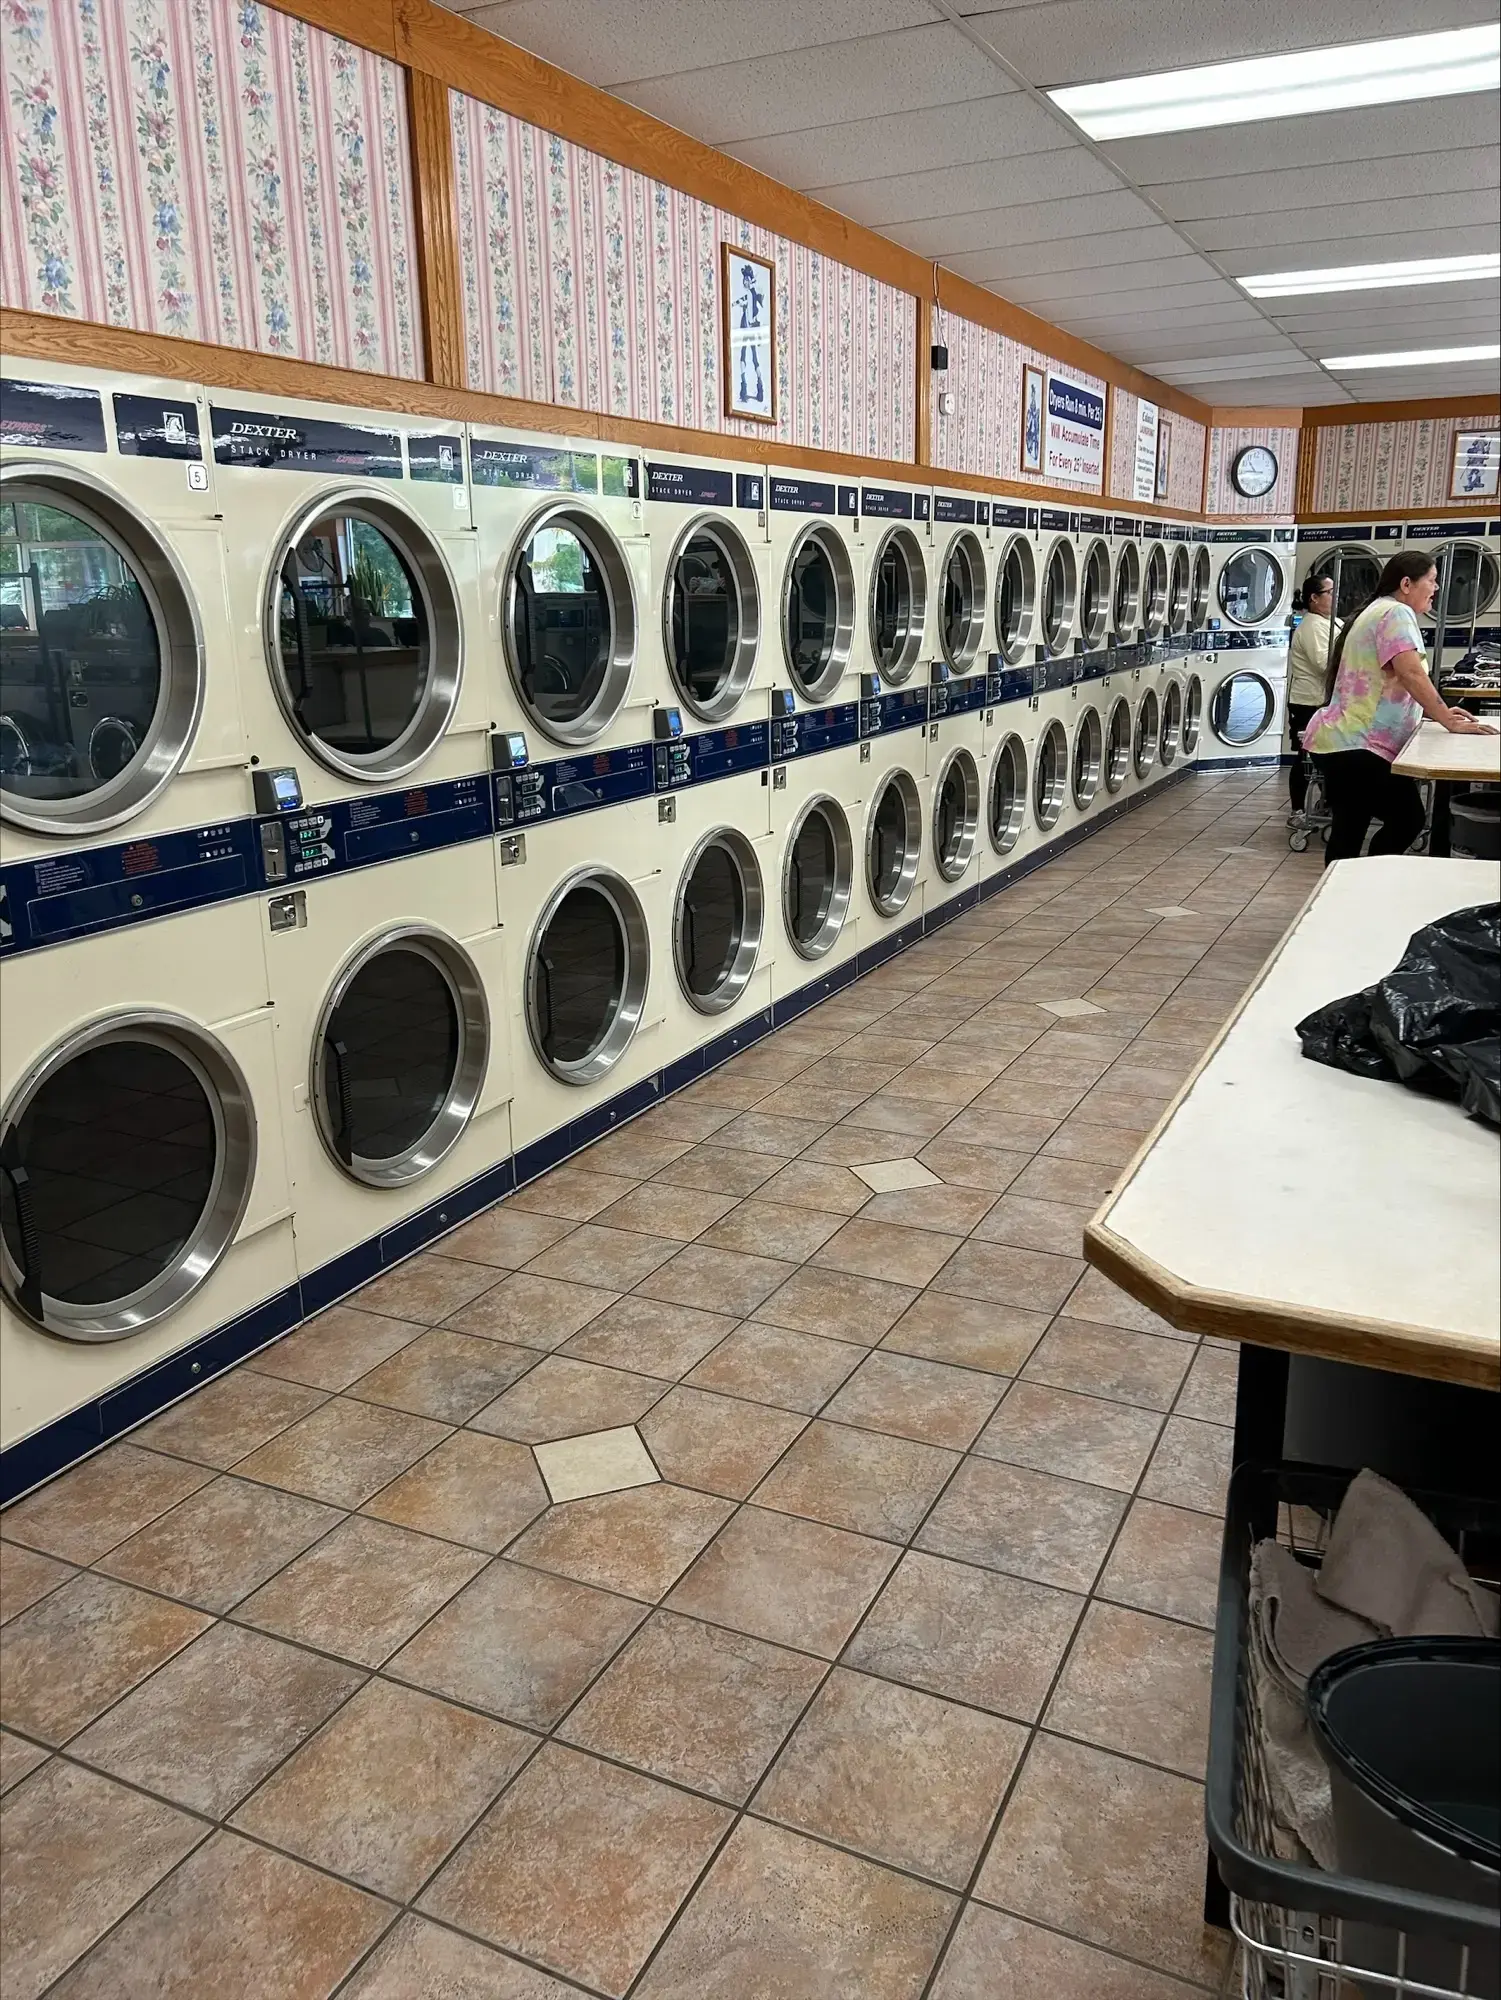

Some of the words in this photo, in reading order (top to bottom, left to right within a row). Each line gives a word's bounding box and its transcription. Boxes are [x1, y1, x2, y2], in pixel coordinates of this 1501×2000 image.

[1049, 389, 1065, 411] Dryers
[1065, 395, 1074, 413] Run
[230, 421, 298, 440] DEXTER
[1050, 422, 1060, 440] Will
[1062, 426, 1089, 447] Accumulate
[1089, 434, 1100, 450] Time
[231, 445, 271, 457] STACK
[280, 449, 318, 461] DRYER
[482, 450, 528, 464] DEXTER
[1049, 451, 1058, 466] For
[1059, 453, 1072, 473] Every
[1082, 458, 1099, 475] Inserted
[194, 471, 201, 483] 5
[483, 468, 509, 478] STACK
[652, 471, 684, 482] DEXTER
[651, 486, 670, 494] STACK
[674, 487, 692, 496] DRYER
[775, 485, 799, 494] DEXTER
[866, 493, 884, 502] DEXTER
